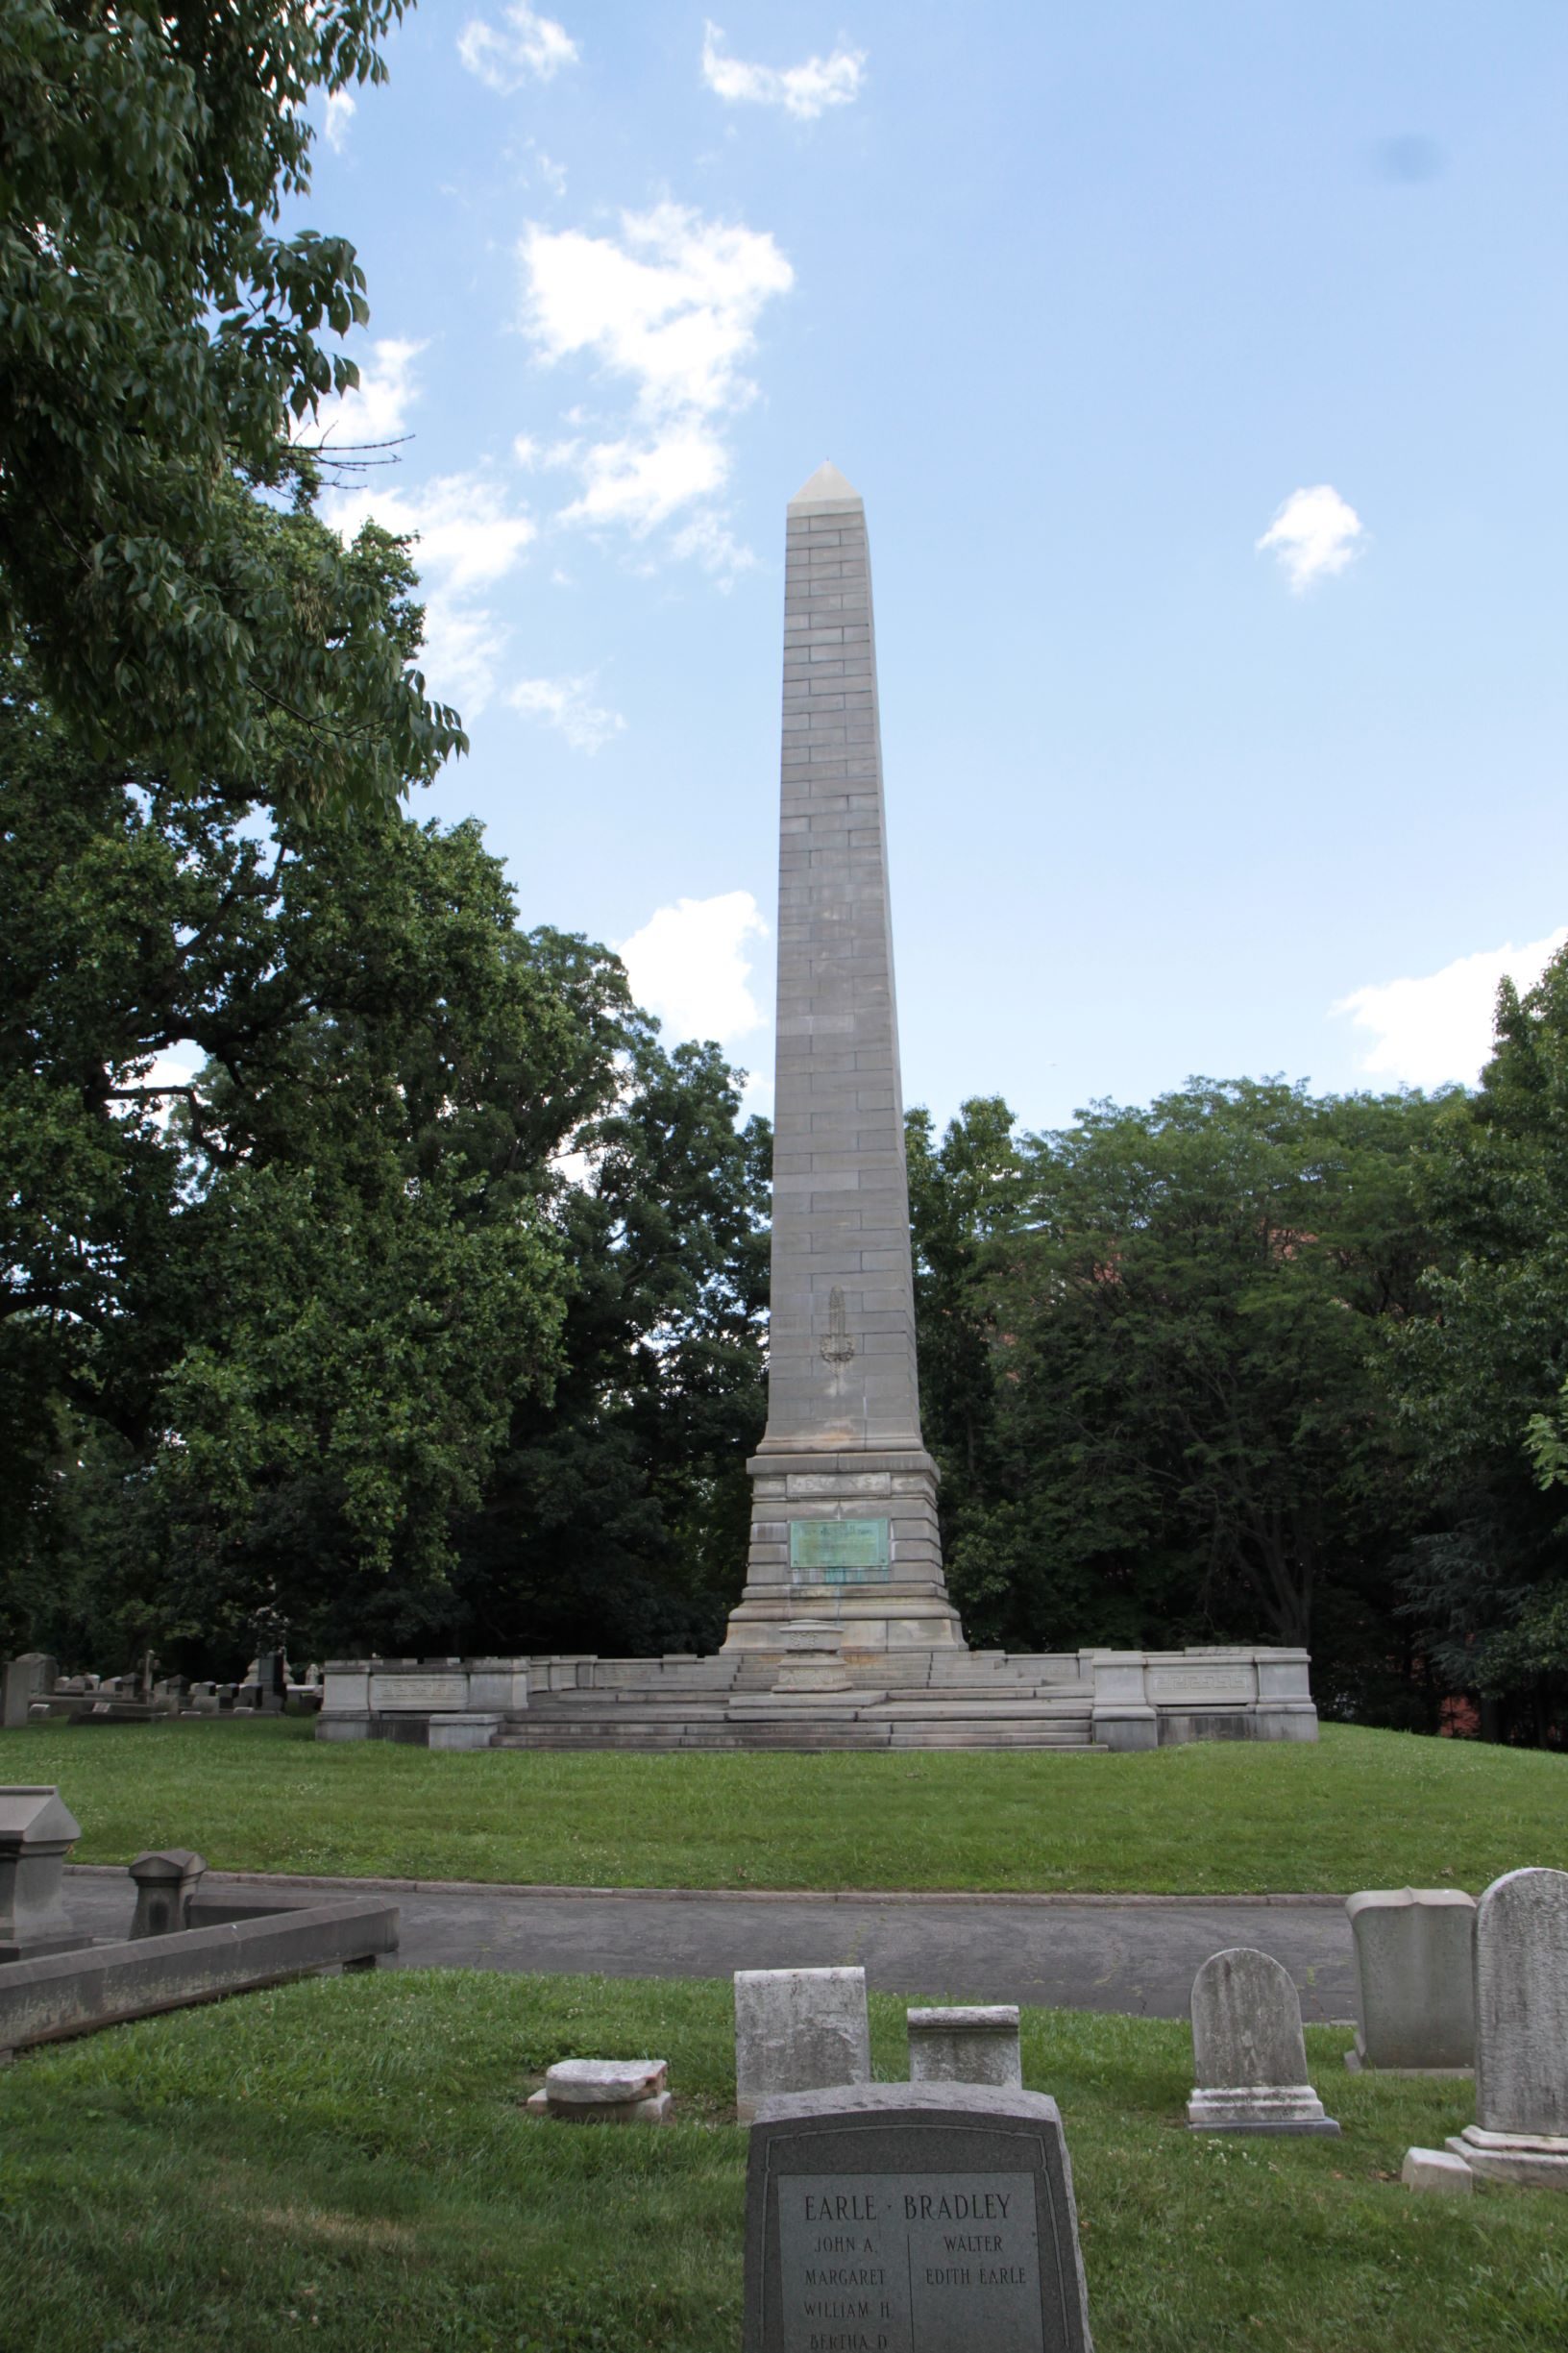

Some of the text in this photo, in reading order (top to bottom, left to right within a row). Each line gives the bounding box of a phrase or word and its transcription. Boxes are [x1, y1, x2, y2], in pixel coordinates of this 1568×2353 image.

[804, 1477, 871, 1490] EVANS
[804, 2194, 1011, 2221] EARLE BRADLEY
[814, 2236, 856, 2253] JOHN
[943, 2236, 1003, 2252] WALTER
[805, 2268, 886, 2286] MARGARET
[925, 2267, 1027, 2285] EDITH EARLE
[803, 2300, 870, 2317] WILLIAM
[809, 2334, 869, 2351] BERTHA
